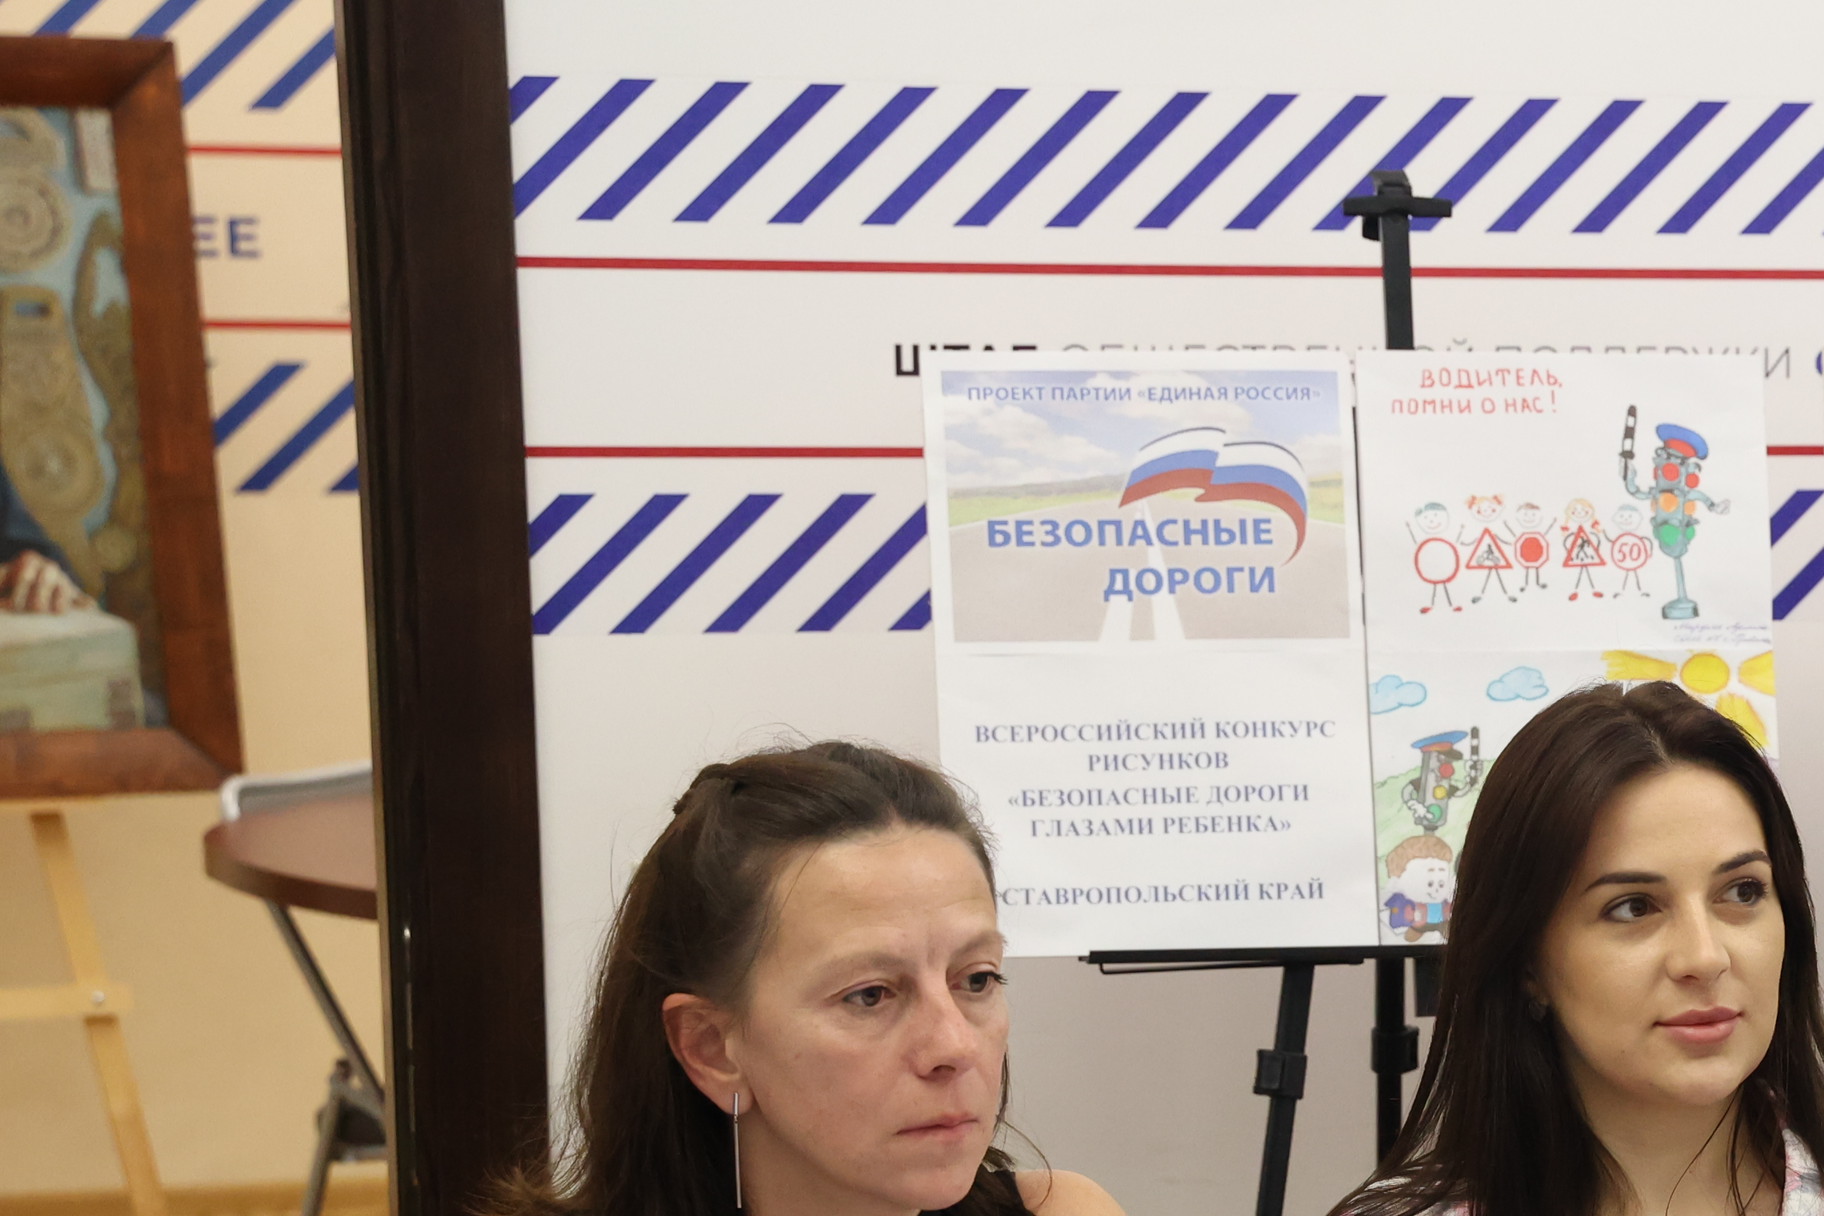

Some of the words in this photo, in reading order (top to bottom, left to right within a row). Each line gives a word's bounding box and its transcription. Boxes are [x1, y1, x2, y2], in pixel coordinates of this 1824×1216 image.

[967, 386, 1045, 401] ПРОЕКТ
[1051, 386, 1132, 401] ПАРТИИ
[1137, 386, 1229, 404] «ЕДИНАЯ
[1234, 386, 1320, 401] РОССИЯ»
[1391, 397, 1472, 415] ПОМНИ
[1480, 397, 1496, 415] О
[987, 518, 1274, 548] БЕЗОПАСНЫЕ
[1617, 542, 1643, 562] 50
[1103, 566, 1276, 602] ДОРОГИ
[975, 716, 1207, 744] ВСЕРОССИЙСКИЙ
[1214, 719, 1337, 741] КОНКУРС
[1087, 750, 1230, 773] РИСУНКОВ
[1008, 787, 1200, 808] «БЕЗОПАСНЫЕ
[1206, 783, 1310, 806] ДОРОГИ
[1030, 816, 1154, 838] ГЛАЗАМИ
[1162, 815, 1292, 836] РЕБЕНКА»
[1002, 881, 1252, 907] СТАВРОПОЛЬСКИЙ
[1258, 878, 1325, 902] КРАЙ
